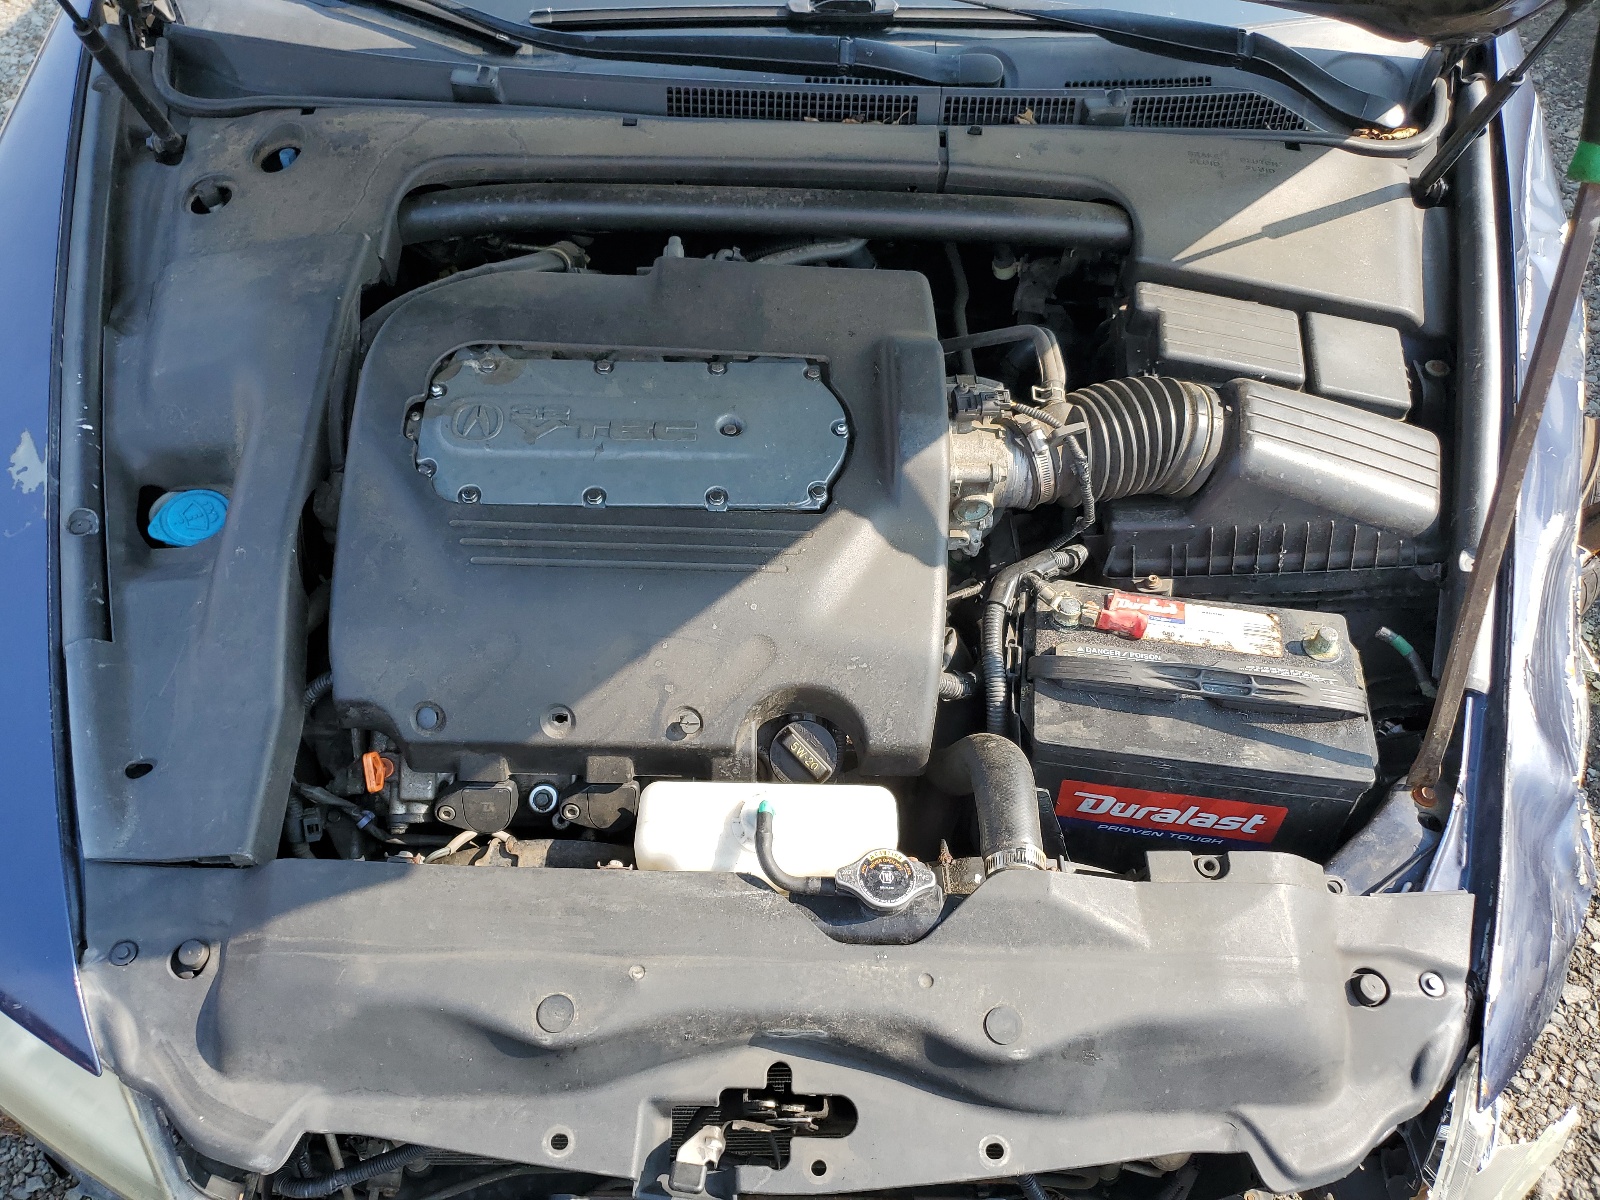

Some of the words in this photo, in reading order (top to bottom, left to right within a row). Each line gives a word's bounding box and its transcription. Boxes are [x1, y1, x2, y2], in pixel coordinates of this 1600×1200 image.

[1085, 646, 1121, 656] DANGER
[1129, 652, 1162, 661] POISON
[1073, 791, 1268, 835] Duralast
[1097, 824, 1164, 838] PROVEN
[1169, 832, 1225, 846] TOUGH
